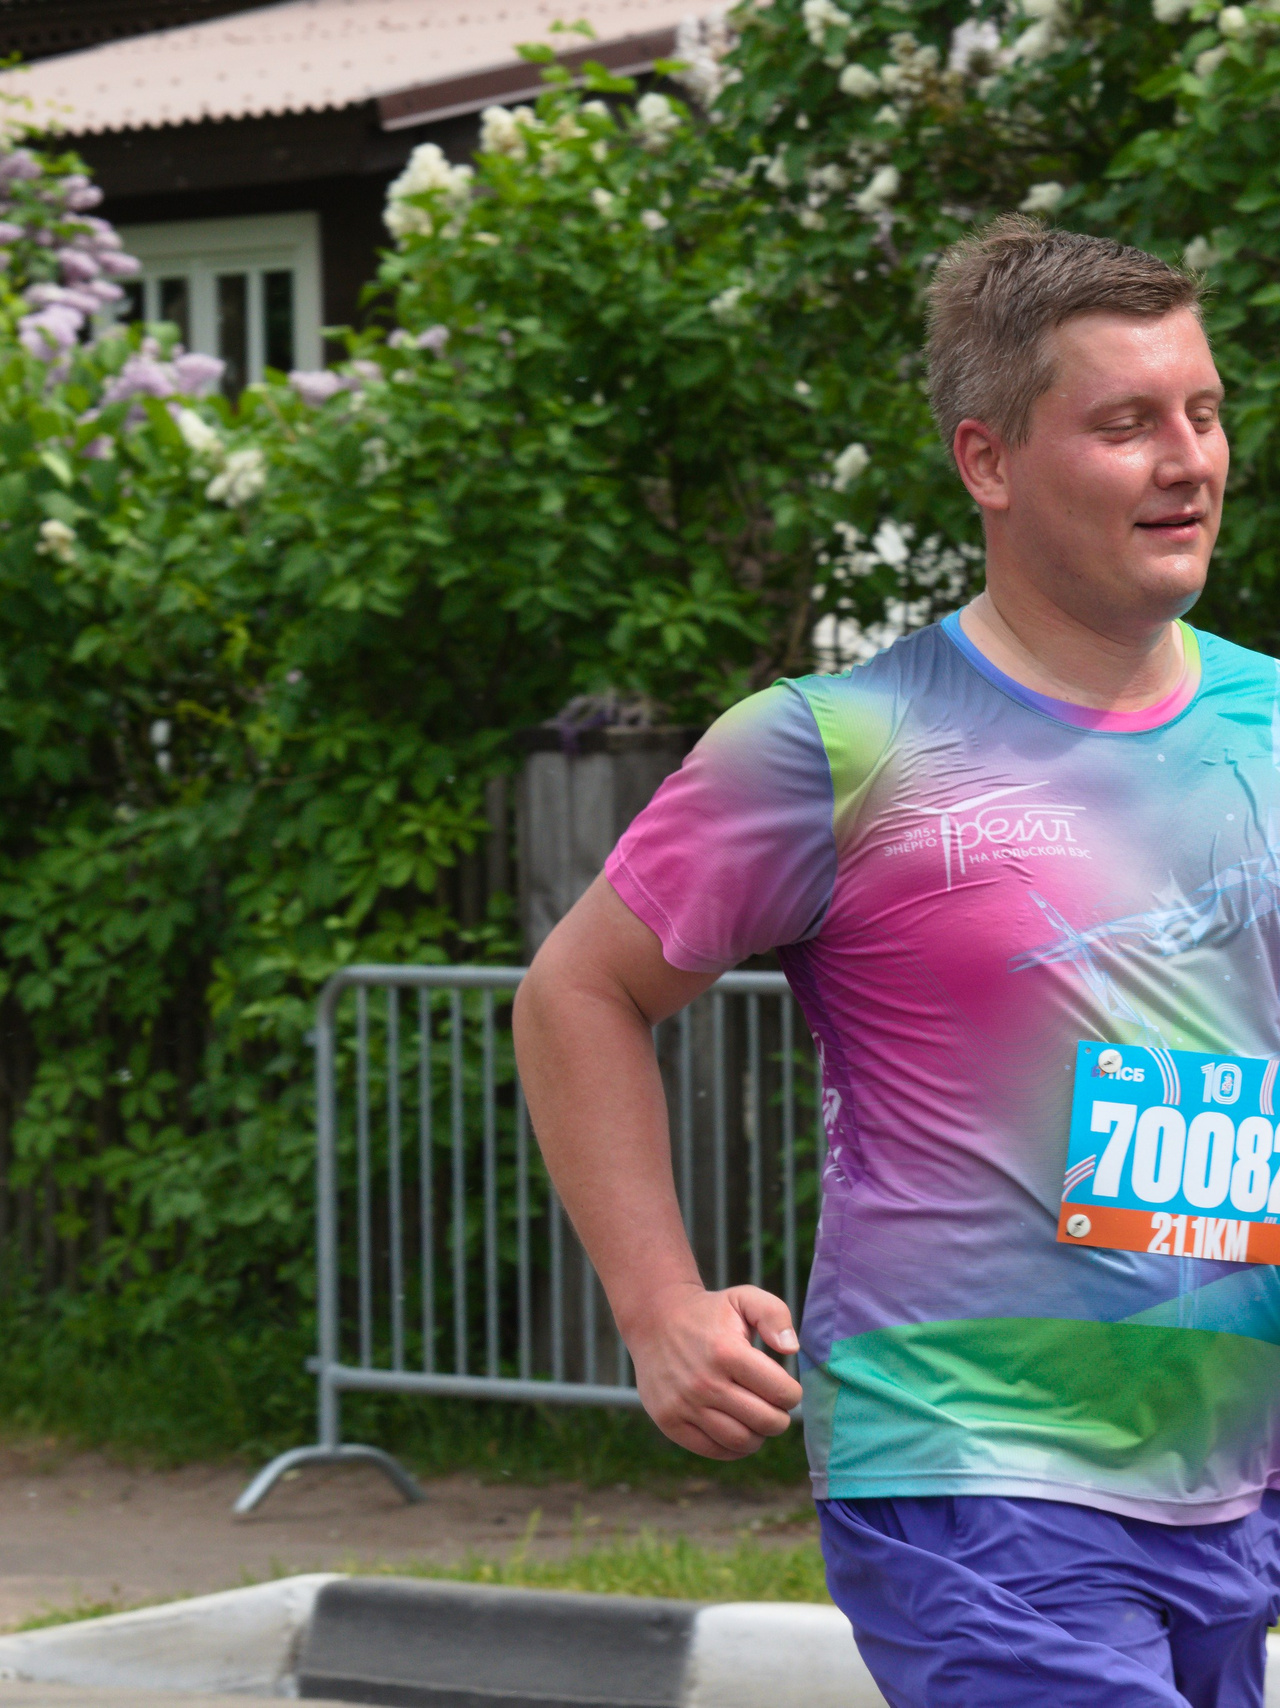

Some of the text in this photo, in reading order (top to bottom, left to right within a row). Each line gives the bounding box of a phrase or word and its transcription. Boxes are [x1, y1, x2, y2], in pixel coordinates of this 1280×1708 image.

[883, 837, 937, 856] ЭНЕРГО
[969, 845, 1093, 864] НА КОЛЬСКОЙ ВЭС
[1200, 1062, 1243, 1105] 10
